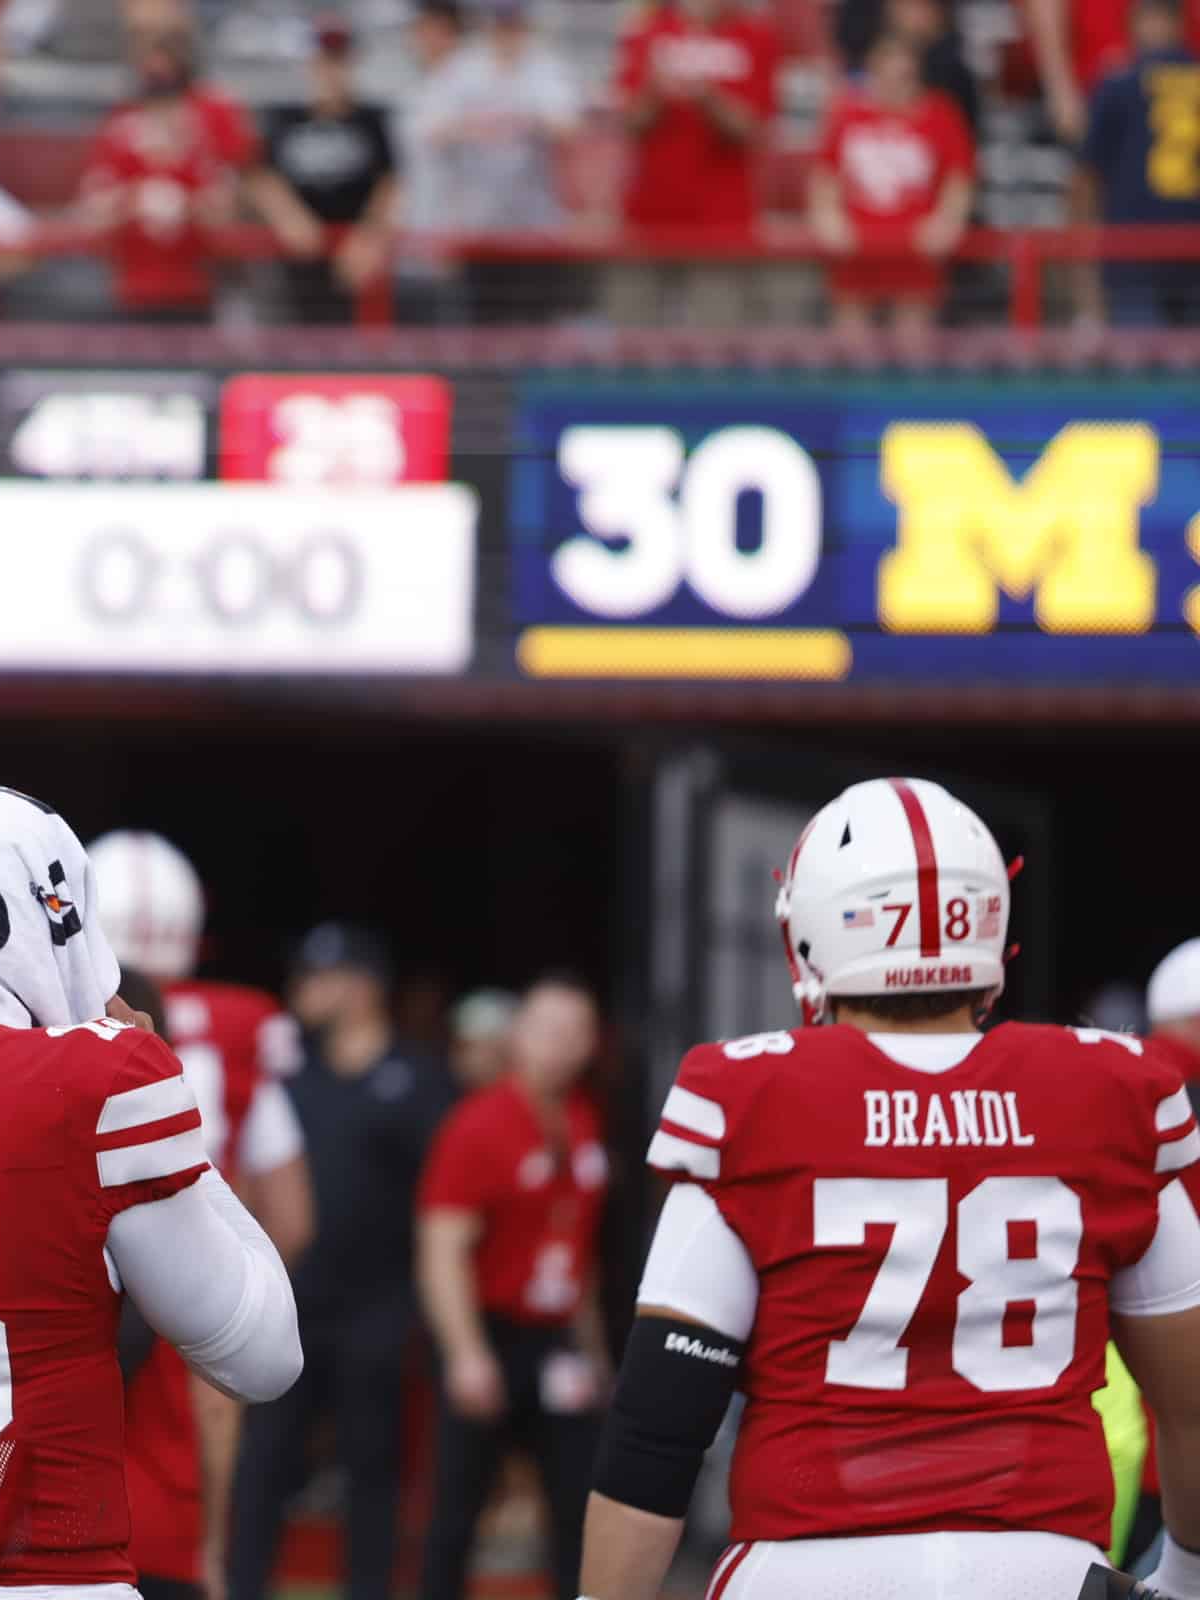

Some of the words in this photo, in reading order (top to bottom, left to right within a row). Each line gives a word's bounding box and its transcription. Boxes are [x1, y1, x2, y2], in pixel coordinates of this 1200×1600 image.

[77, 525, 367, 632] 0:00
[550, 424, 823, 618] 30
[878, 419, 1161, 635] M
[885, 966, 972, 987] HUSKERS
[864, 1091, 1035, 1147] BRANDL
[813, 1176, 1083, 1392] 78
